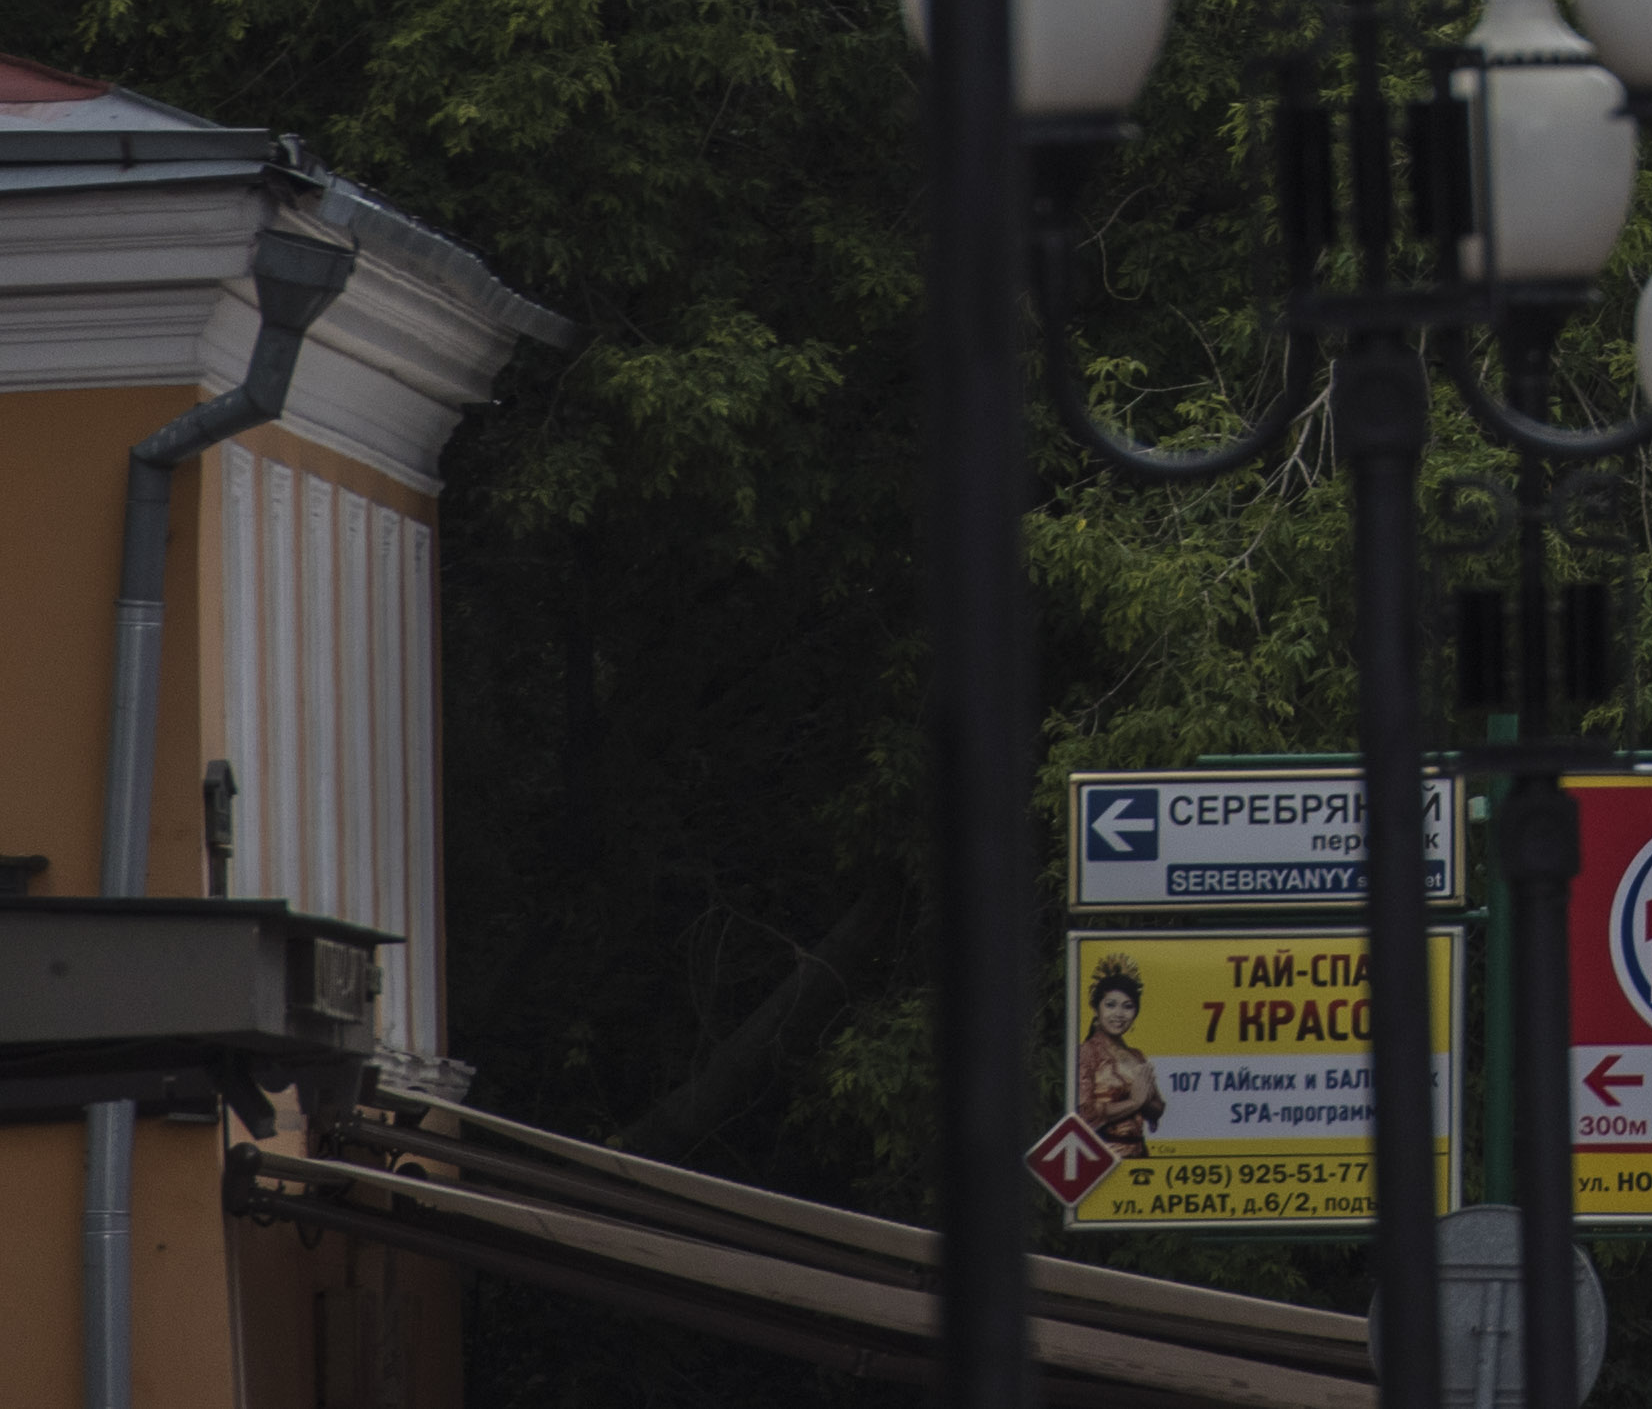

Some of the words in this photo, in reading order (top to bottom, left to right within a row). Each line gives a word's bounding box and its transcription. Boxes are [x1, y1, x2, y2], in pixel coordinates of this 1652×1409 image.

[1168, 784, 1442, 827] СЕРЕБРЯНЙ
[1312, 832, 1440, 856] перк
[1170, 867, 1354, 894] SEREBRYANYY
[1356, 873, 1443, 890] set
[1227, 949, 1371, 989] ТАЙ-СПА
[1202, 1002, 1226, 1043] 7
[1239, 999, 1374, 1043] КРАСО
[1170, 1072, 1200, 1093] 107
[1211, 1067, 1297, 1092] ТАЙских
[1305, 1075, 1317, 1090] и
[1578, 1115, 1648, 1136] 300м
[1165, 1164, 1232, 1189] (495)
[1239, 1162, 1370, 1185] 925-51-77
[1578, 1177, 1610, 1194] ул.
[1112, 1199, 1143, 1215] ул.
[1150, 1193, 1237, 1217] АРБАТ,
[1243, 1193, 1318, 1216] д.6/2,
